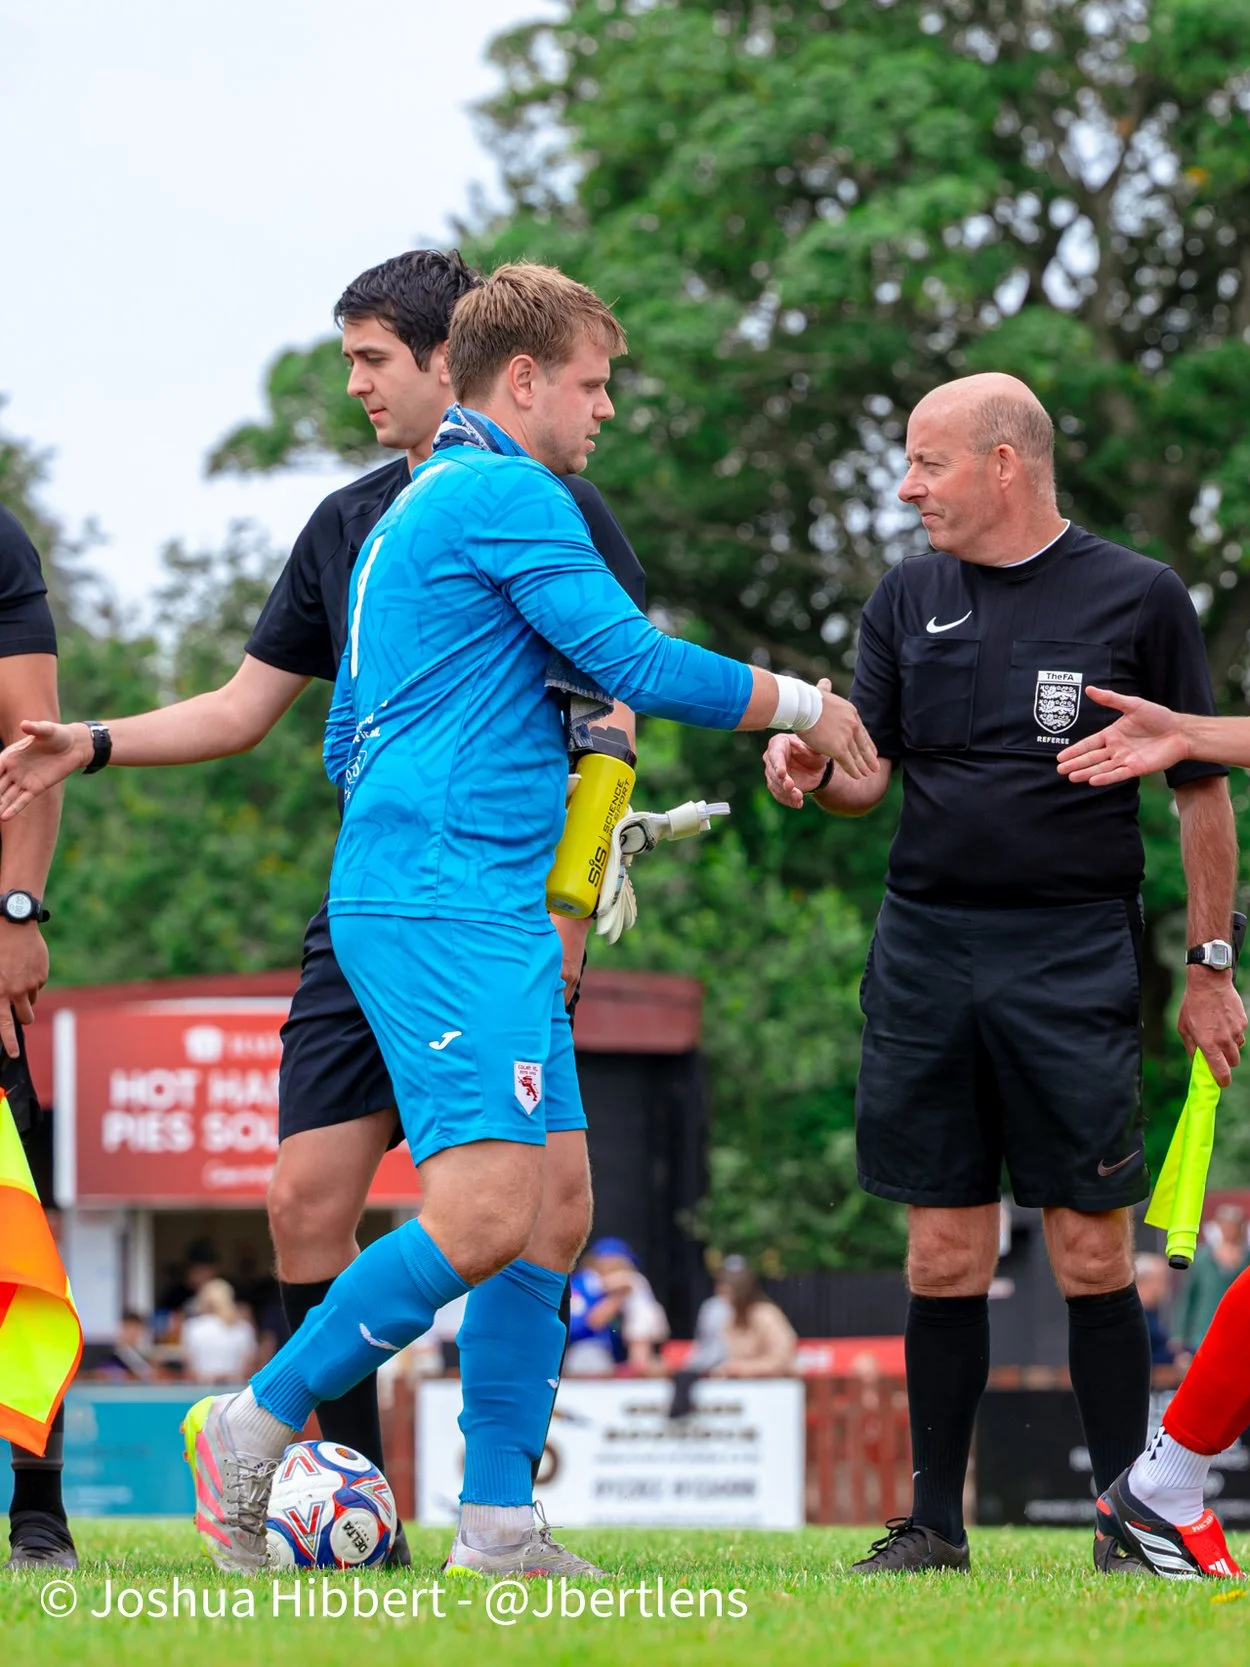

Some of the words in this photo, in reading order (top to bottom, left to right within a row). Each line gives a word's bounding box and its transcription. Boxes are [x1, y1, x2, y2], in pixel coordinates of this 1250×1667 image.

[1036, 736, 1070, 745] REFEREE
[603, 779, 625, 834] SCIENCE
[613, 778, 630, 820] SPORT
[111, 1070, 199, 1107] HOT
[104, 1113, 193, 1151] PIES
[342, 1520, 369, 1553] DELTA
